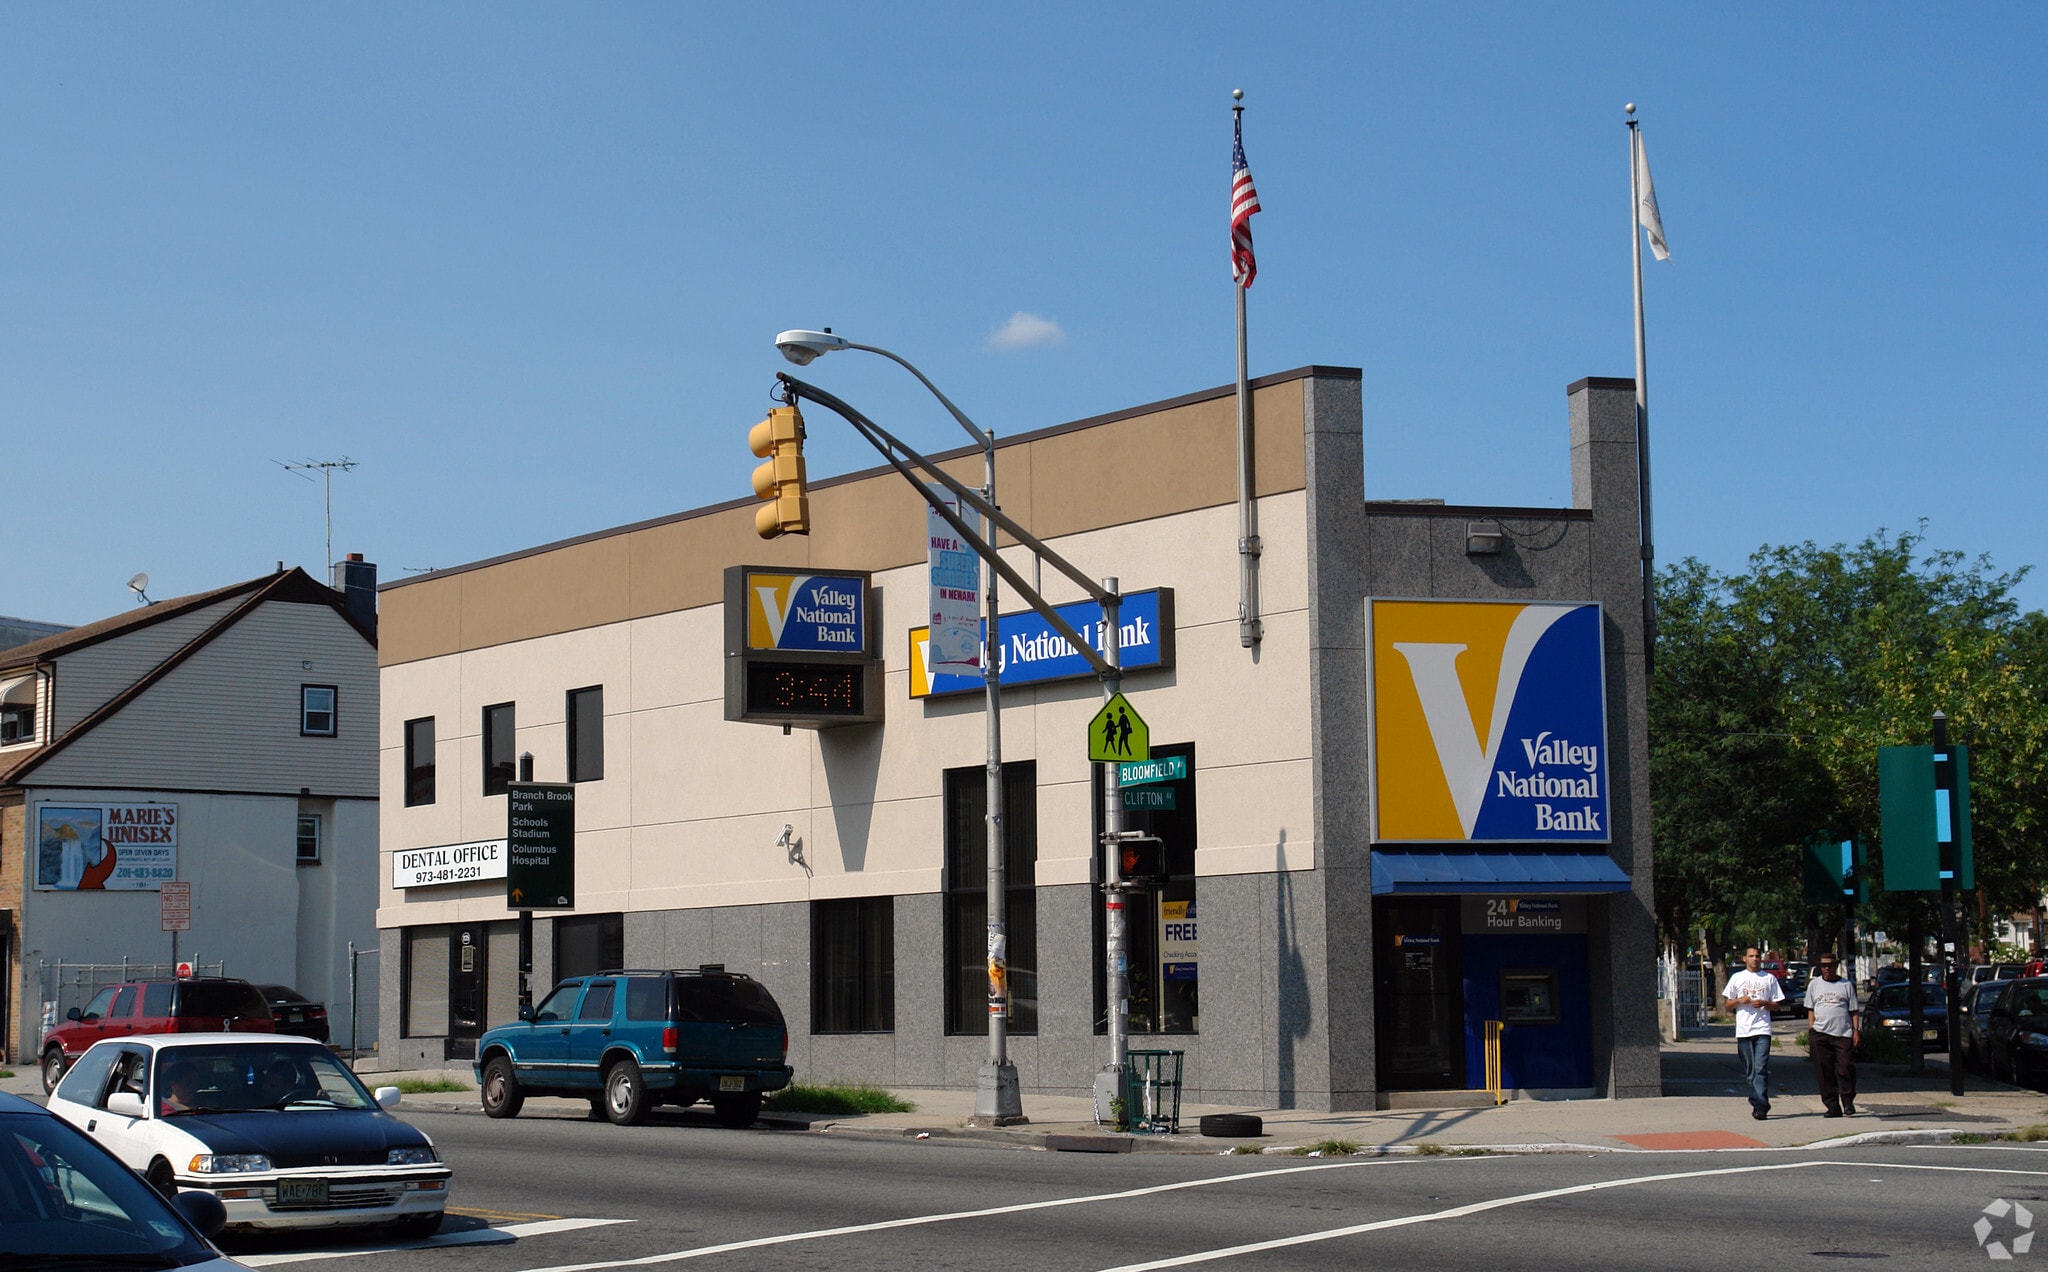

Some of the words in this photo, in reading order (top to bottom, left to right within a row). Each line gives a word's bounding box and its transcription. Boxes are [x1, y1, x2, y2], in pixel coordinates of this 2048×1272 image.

[931, 536, 950, 550] HAVE
[952, 539, 958, 551] A
[940, 551, 973, 572] SUPER
[931, 567, 977, 590] SUMMER
[811, 586, 856, 610] Valley
[940, 588, 947, 599] IN
[949, 589, 976, 602] NEWARK
[796, 606, 856, 625] National
[817, 626, 856, 643] Bank
[1521, 731, 1598, 773] Valley
[1122, 761, 1175, 782] BLOOMFIELD
[1497, 770, 1600, 799] National
[512, 790, 545, 800] Branch
[547, 791, 574, 801] Brook
[1124, 791, 1163, 806] CLIFTON
[512, 801, 533, 811] Park
[108, 807, 175, 825] MARIE'S
[512, 817, 549, 827] Schools
[1535, 803, 1602, 831] Bank
[108, 825, 172, 843] UNISEX
[512, 829, 550, 839] Stadium
[118, 848, 133, 856] OPEN
[134, 848, 152, 856] SEVEN
[153, 848, 170, 856] DAYS
[402, 850, 450, 870] DENTAL
[453, 844, 498, 864] OFFICE
[512, 844, 557, 854] Columbus
[512, 855, 550, 867] Hospital
[415, 866, 482, 883] 973-481-2231
[1487, 899, 1508, 916] 24
[1487, 916, 1515, 928] Hour
[1518, 915, 1562, 930] Banking
